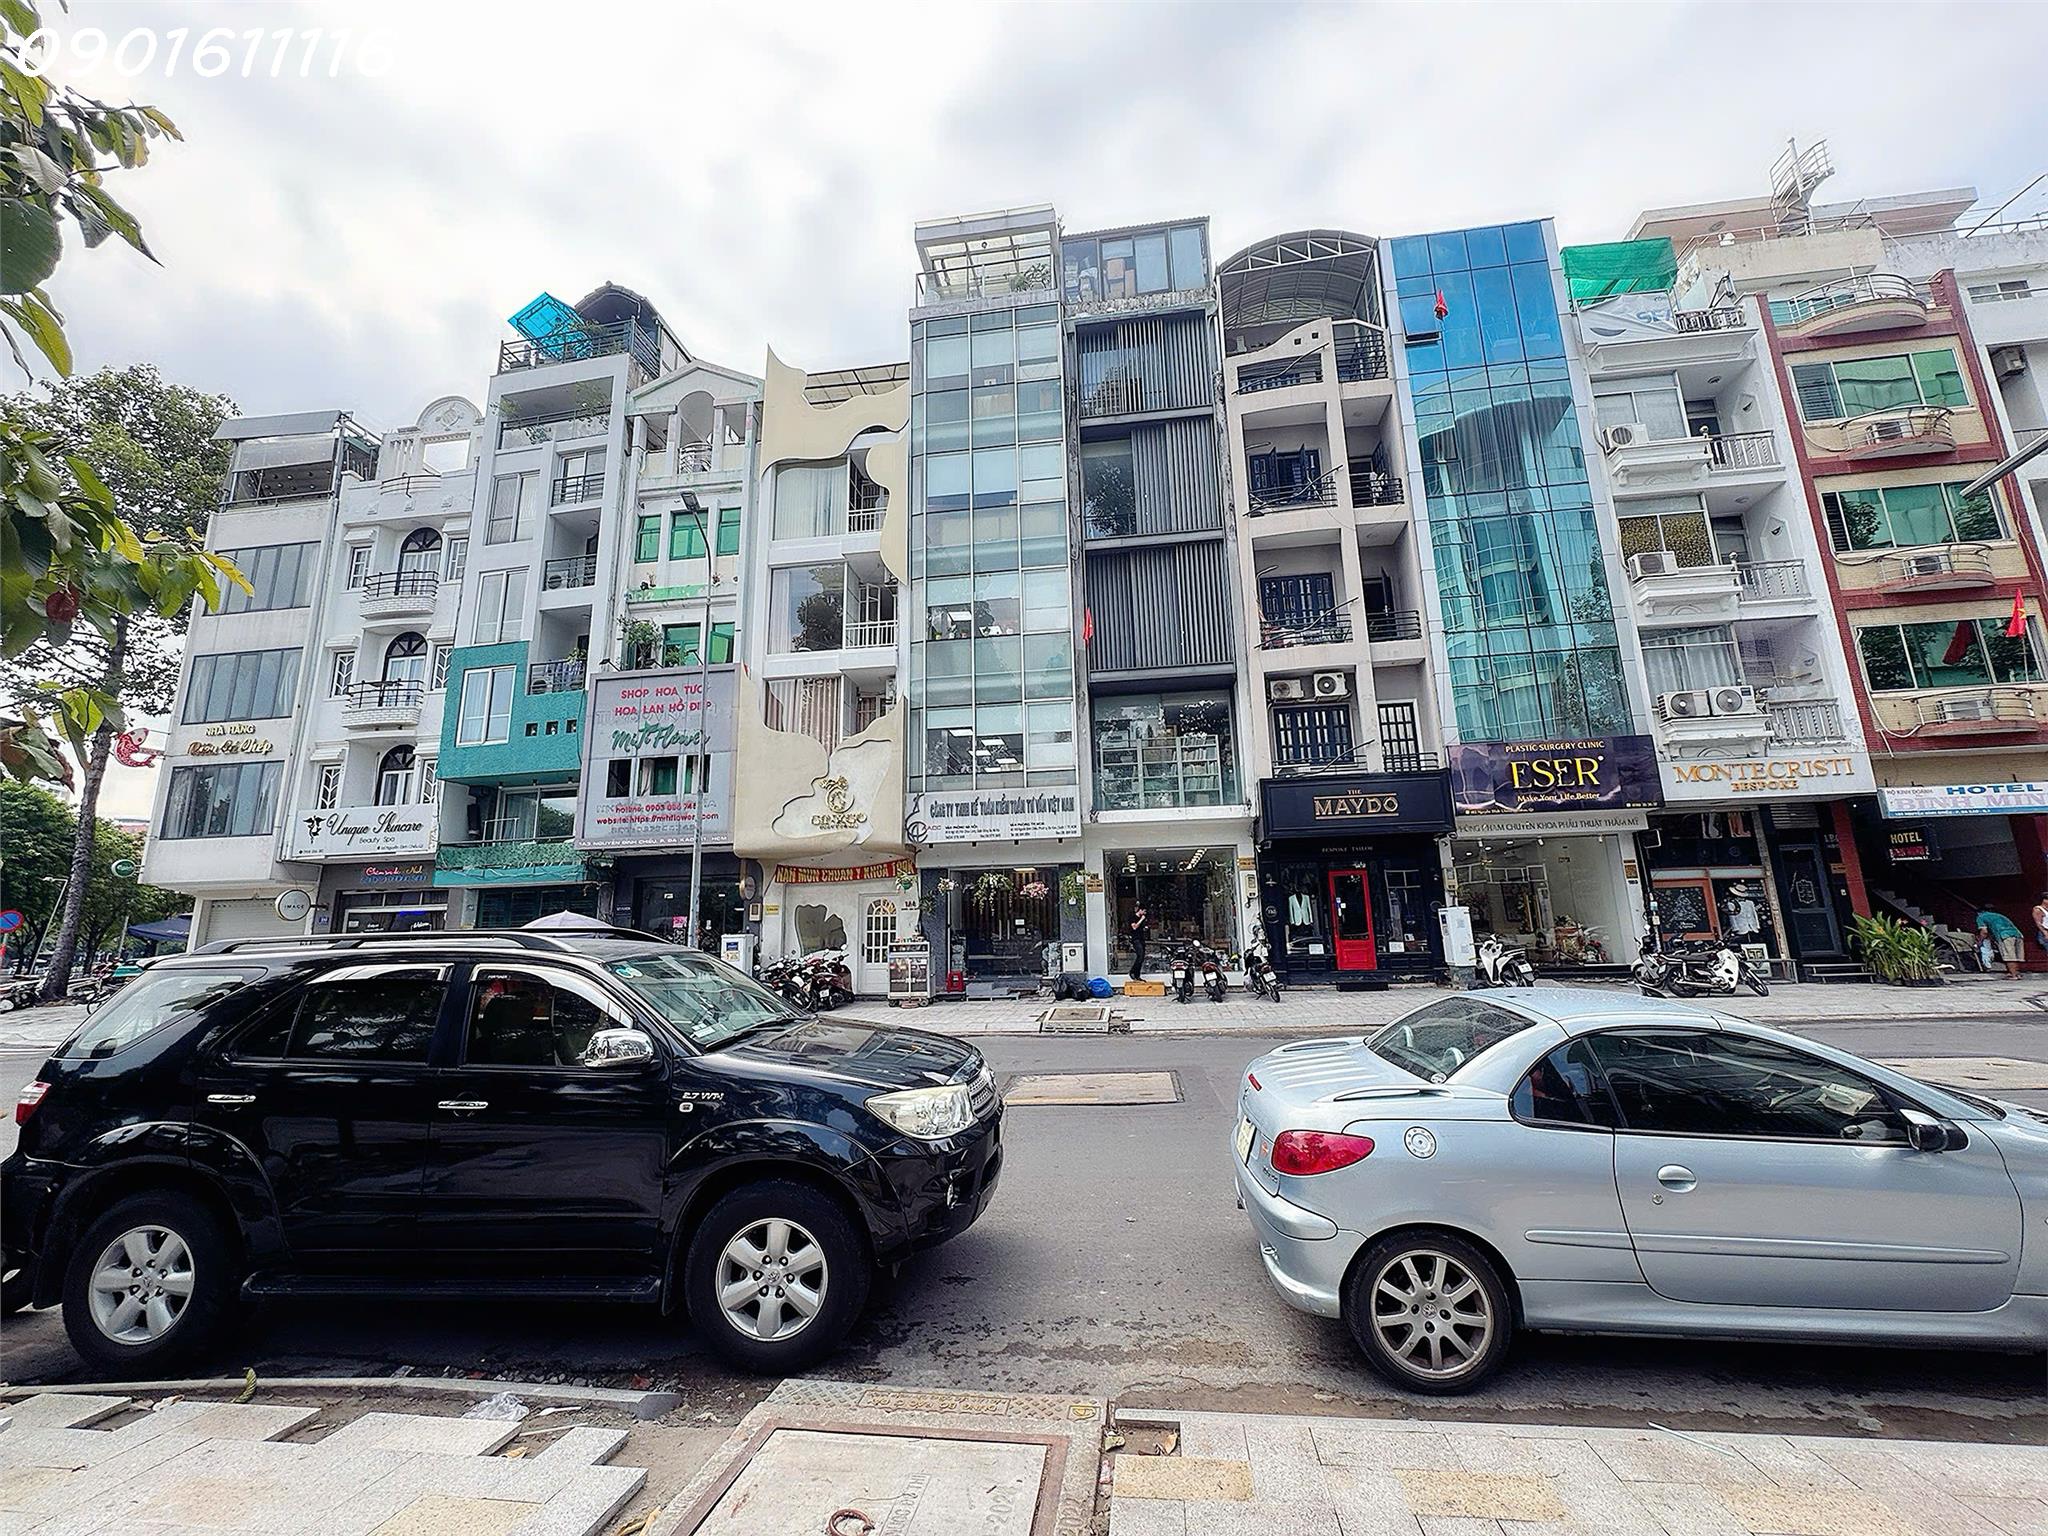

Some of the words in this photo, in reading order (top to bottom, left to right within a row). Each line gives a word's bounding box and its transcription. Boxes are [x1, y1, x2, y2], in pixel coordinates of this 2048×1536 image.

[621, 689, 649, 699] SHOP
[655, 687, 679, 697] HOA
[615, 706, 638, 716] HOA
[643, 704, 664, 714] LAN
[689, 702, 712, 712] ĐP
[1505, 744, 1538, 753] PLASTIC
[1539, 742, 1577, 751] SURGERY
[1577, 740, 1605, 750] CLINIC
[1511, 757, 1600, 789] ESER
[1673, 758, 1855, 783] MONTECRISTI
[1731, 780, 1799, 792] BESPOKE
[1946, 784, 2043, 795] HOTEL
[1576, 792, 1600, 800] Better
[1314, 796, 1399, 816] MAYDO
[326, 813, 369, 846] Unique
[372, 811, 424, 834] Skincare
[1890, 832, 1922, 844] HOTEL
